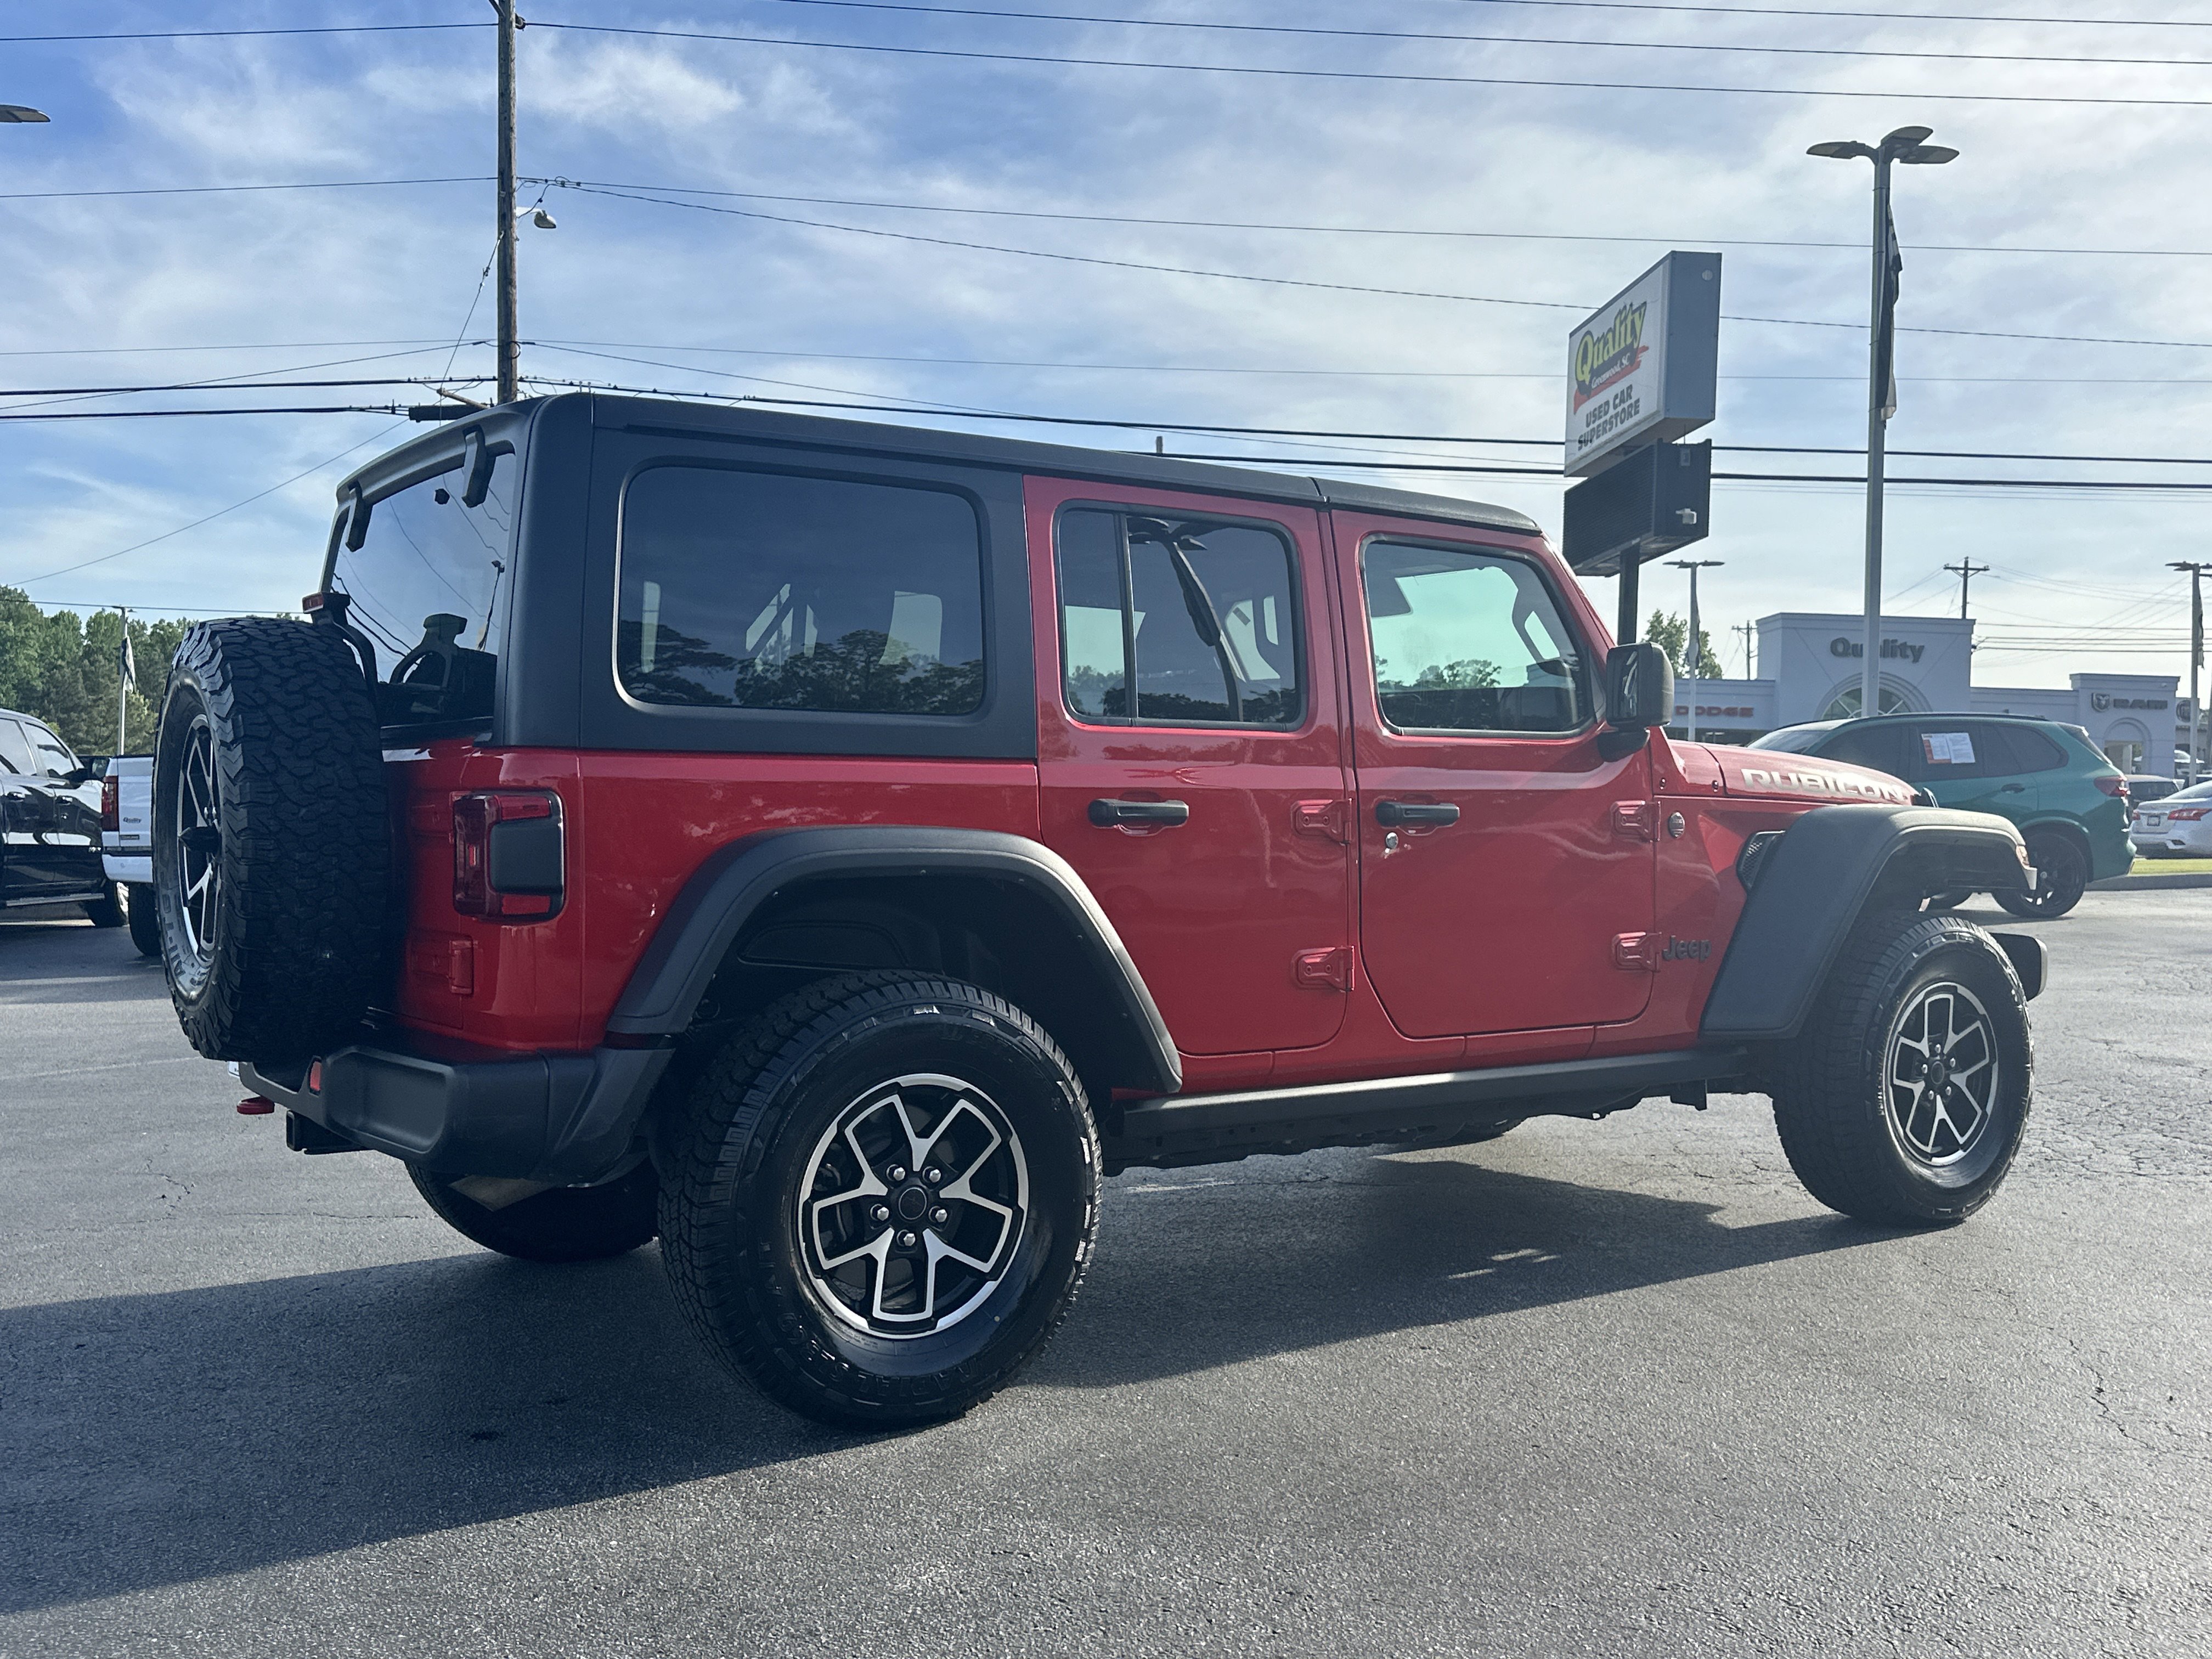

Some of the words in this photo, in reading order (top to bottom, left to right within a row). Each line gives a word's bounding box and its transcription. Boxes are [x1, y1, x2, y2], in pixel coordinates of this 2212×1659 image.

[1576, 304, 1646, 386] Quality
[1585, 399, 1610, 428] USED
[1612, 384, 1633, 410] CAR
[1578, 398, 1640, 452] SUPERSTORE
[1830, 637, 1925, 663] Qulity
[1675, 706, 1754, 718] DODGE
[2113, 698, 2168, 710] RAM
[1741, 768, 1905, 802] RUBICON
[1662, 935, 1712, 963] Jeep
